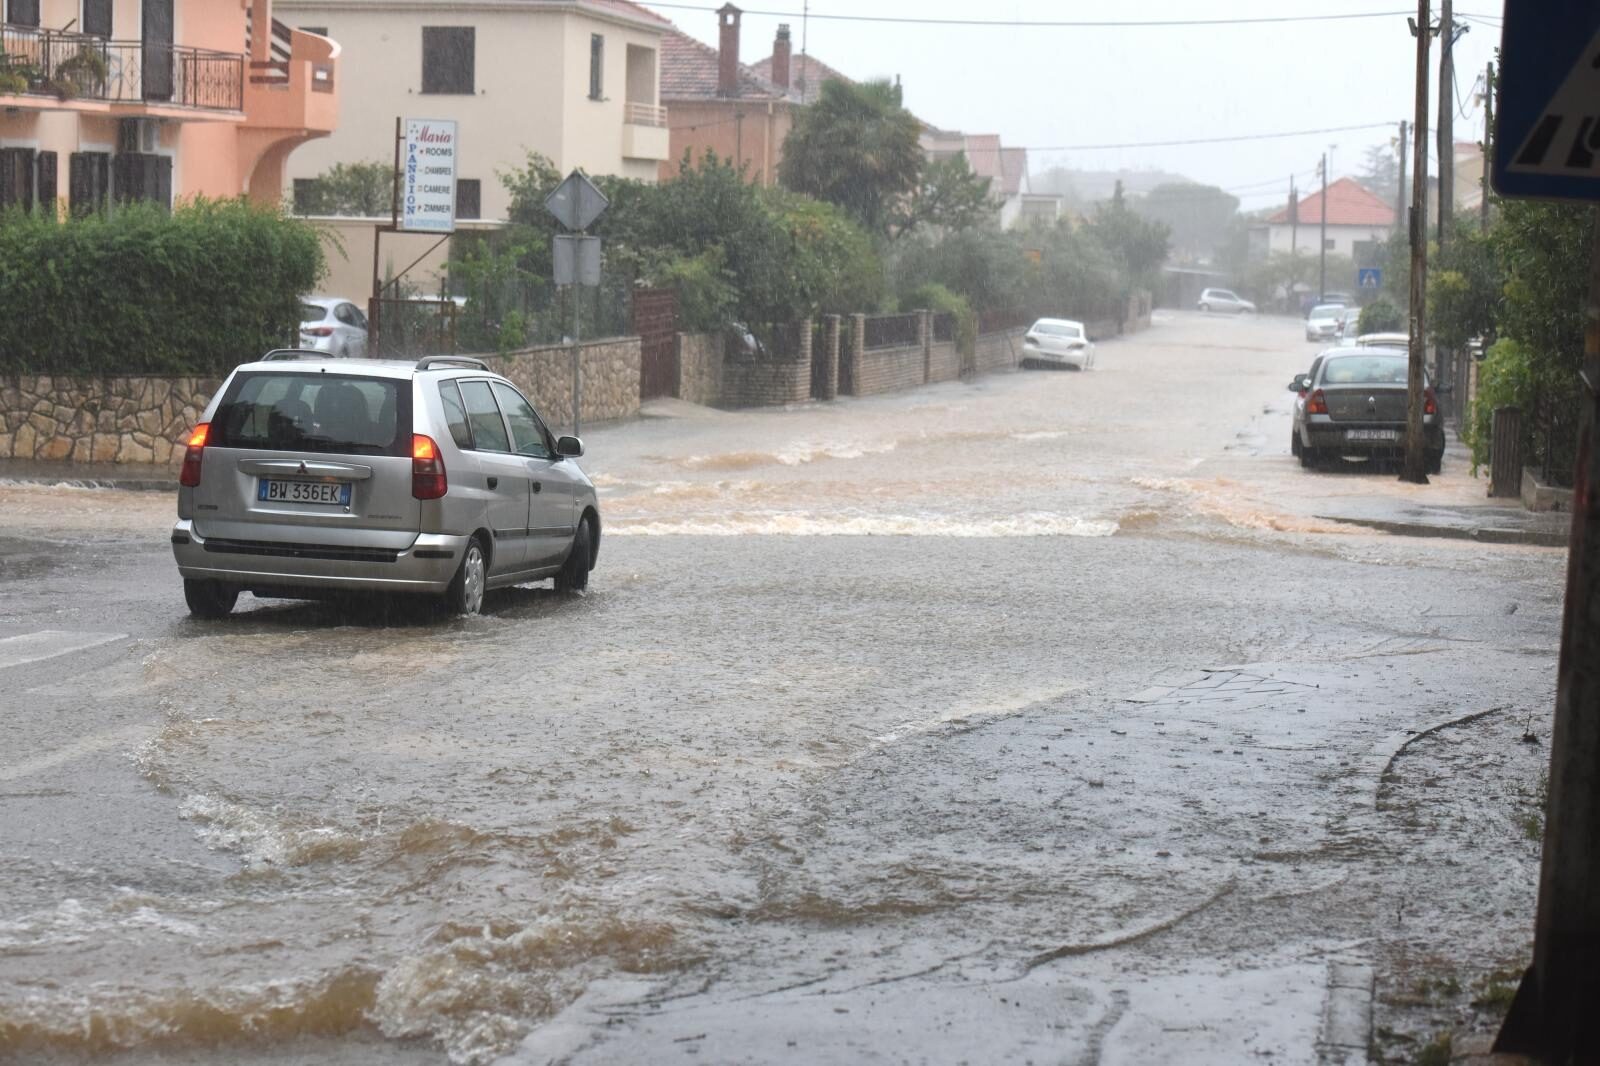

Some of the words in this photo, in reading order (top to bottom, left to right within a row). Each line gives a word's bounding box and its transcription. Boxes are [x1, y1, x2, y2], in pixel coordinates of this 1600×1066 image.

[416, 125, 452, 143] Maria
[426, 147, 453, 157] ROOMS
[407, 143, 417, 215] PANSION
[423, 184, 451, 194] CAMERE
[423, 203, 451, 213] ZIMMER
[269, 482, 288, 499] BW
[292, 483, 339, 502] 336EK
